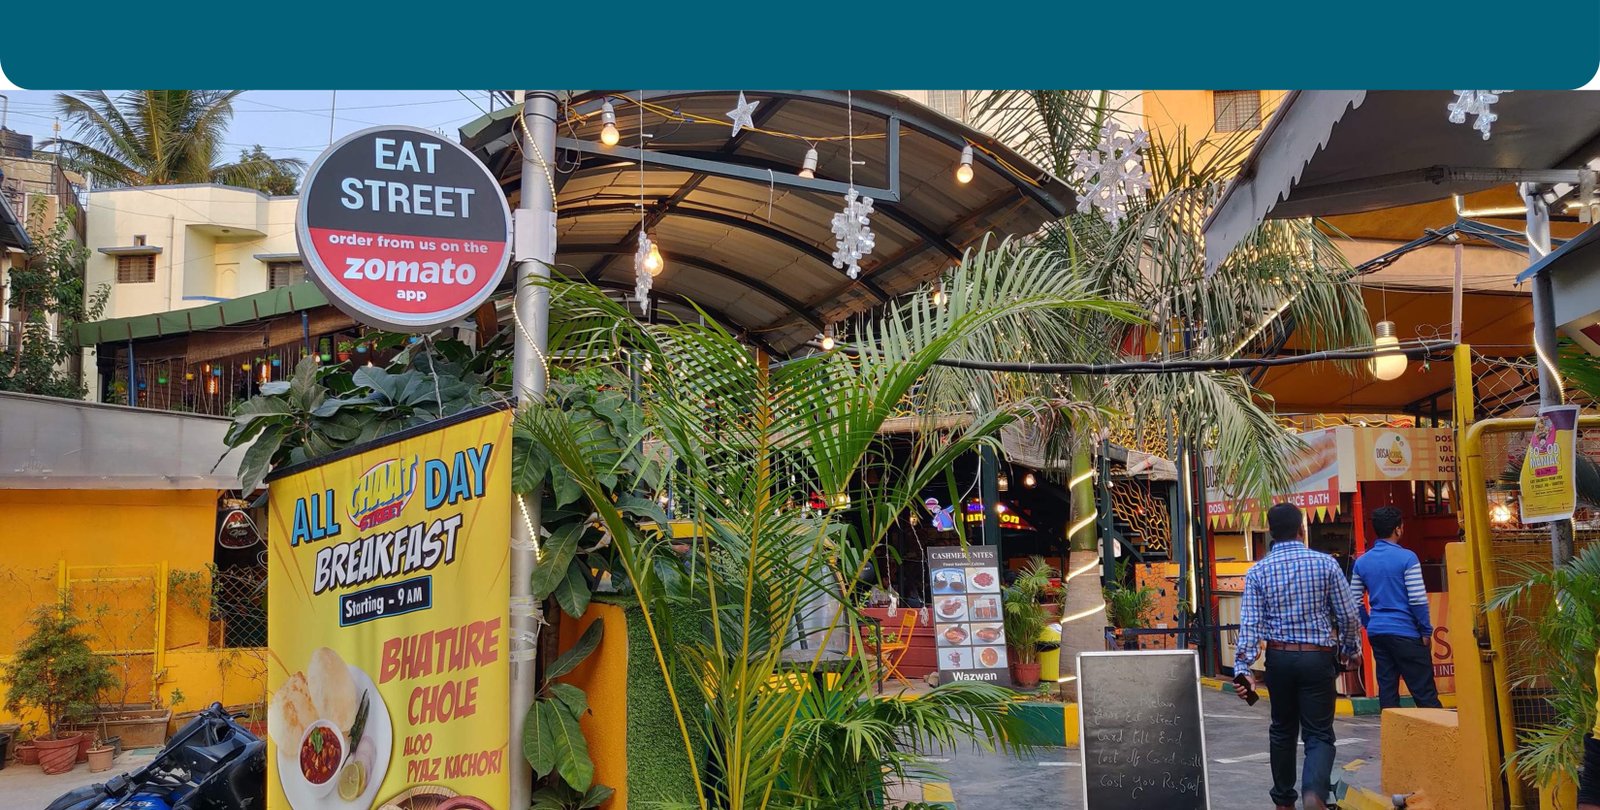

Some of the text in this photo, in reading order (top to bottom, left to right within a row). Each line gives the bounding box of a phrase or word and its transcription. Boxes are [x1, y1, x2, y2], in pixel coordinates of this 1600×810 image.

[375, 138, 441, 174] EAT
[340, 177, 476, 218] STREET
[329, 233, 489, 254] order from us on the
[344, 256, 476, 285] zomato
[396, 288, 427, 302] app
[1435, 435, 1452, 443] DOS
[291, 443, 494, 547] ALL CHAAT DAY
[1308, 493, 1330, 505] BATH
[360, 500, 404, 532] STREET
[313, 513, 463, 595] BREAKFAST
[931, 551, 994, 560] CASHMER NITES
[345, 596, 385, 618] Starting
[397, 588, 406, 607] 9
[406, 585, 423, 605] AM
[379, 616, 501, 684] BHATURE
[952, 671, 997, 682] Wazwan
[407, 677, 479, 726] CHOLE
[403, 733, 433, 757] ALOO
[406, 750, 503, 783] PYAZ KACHORI
